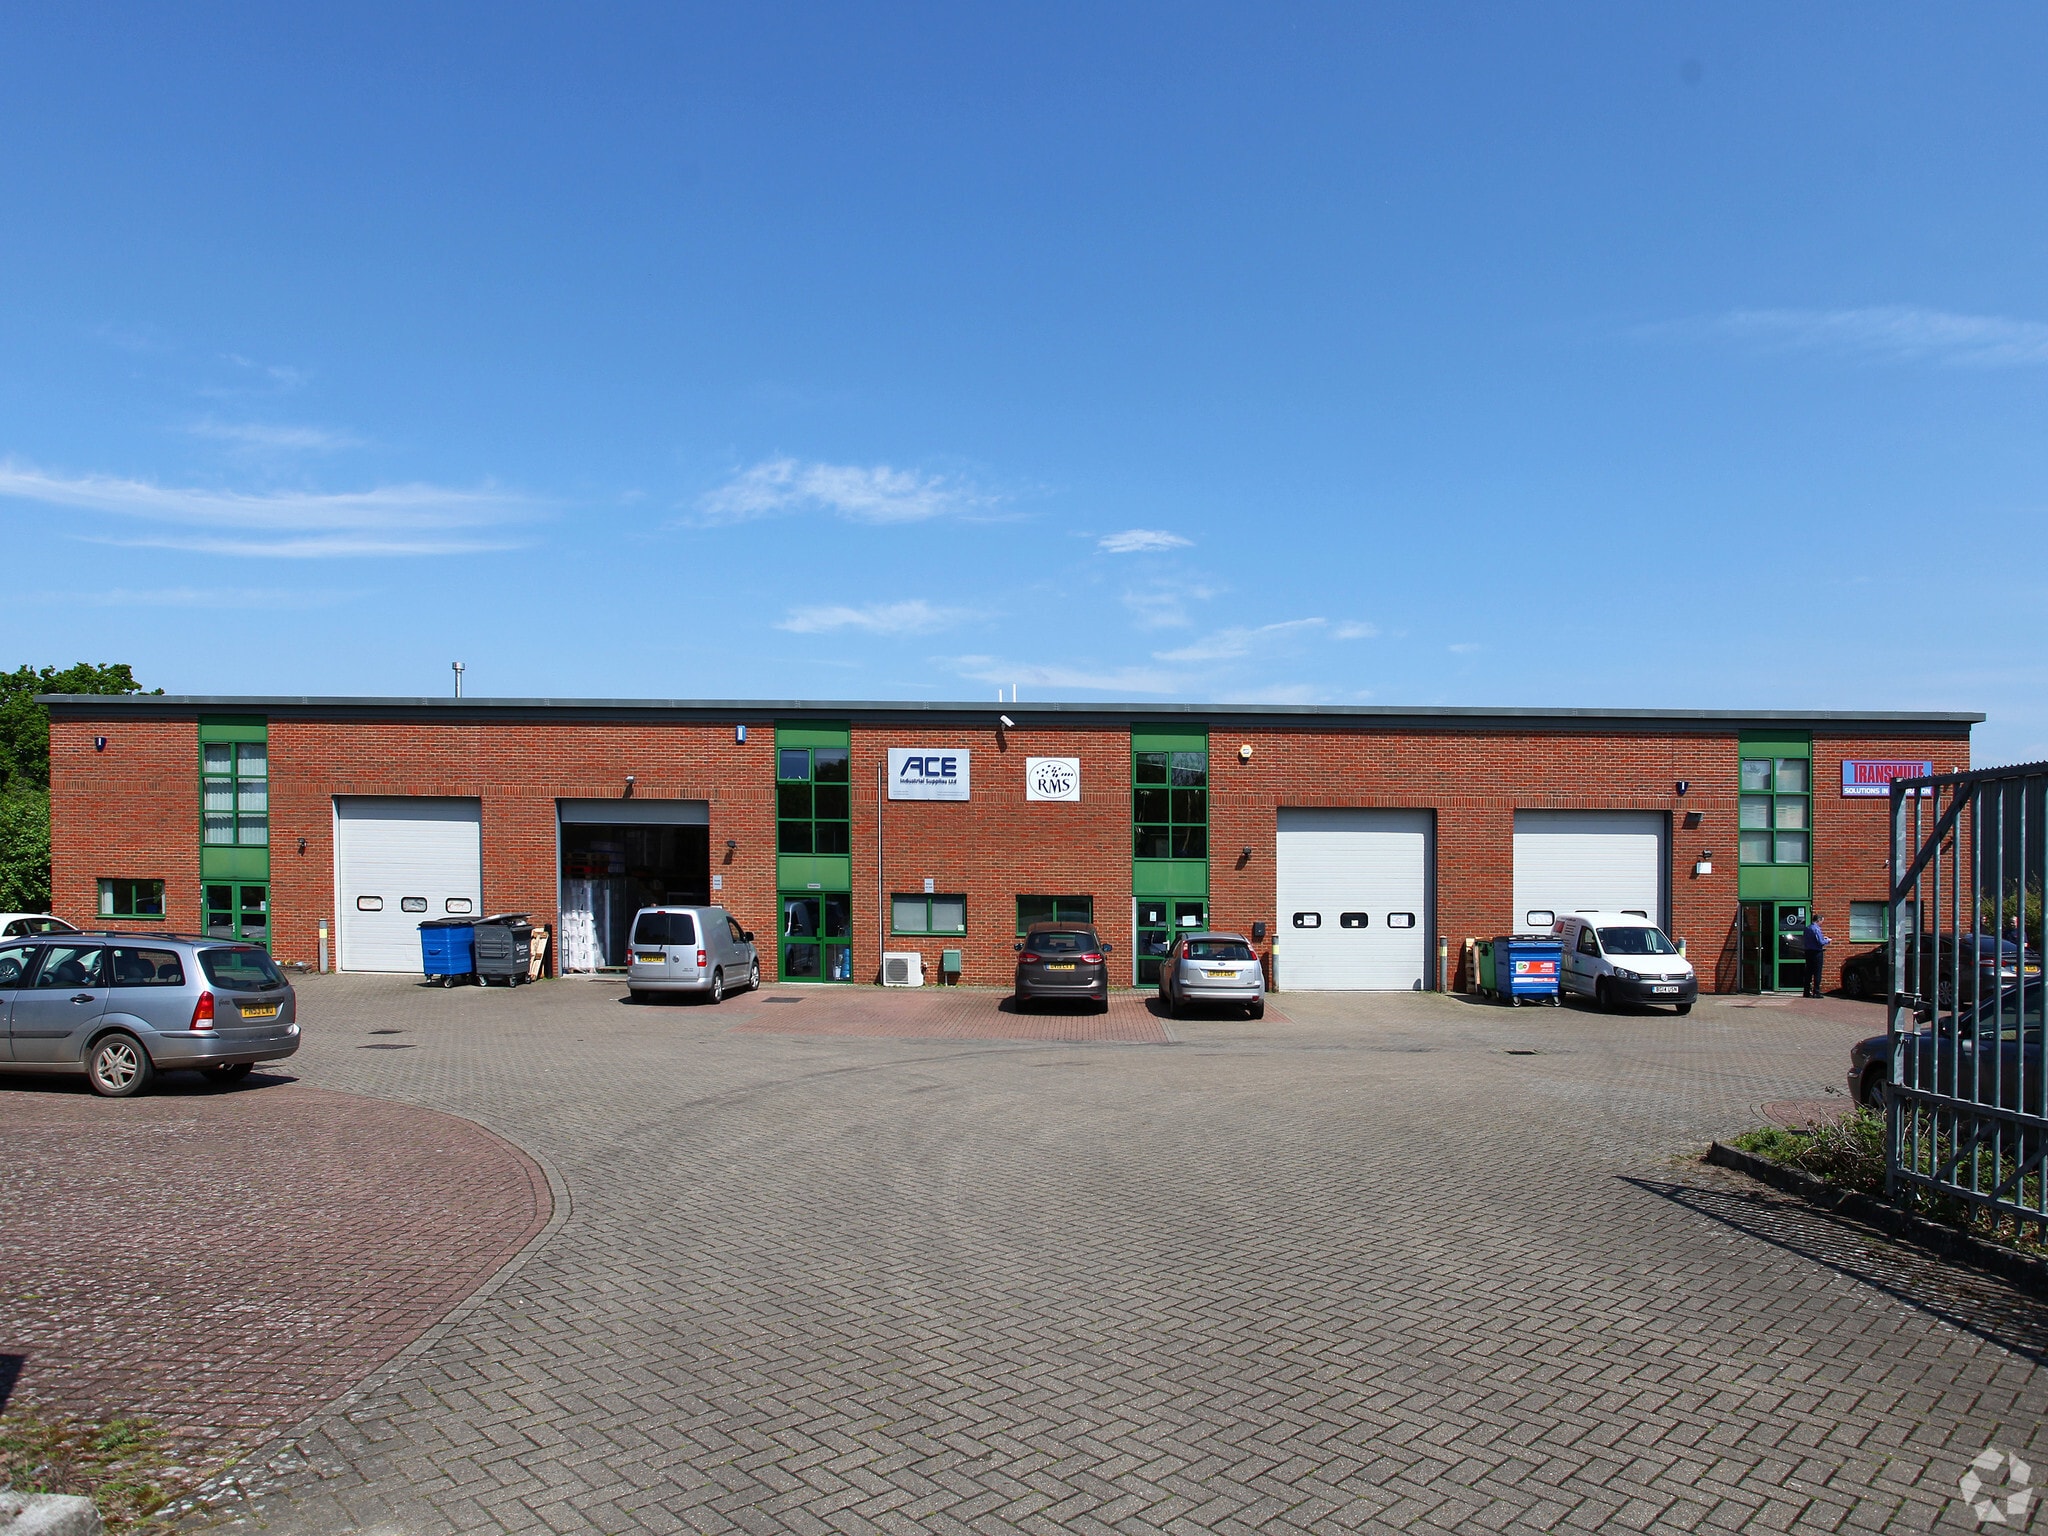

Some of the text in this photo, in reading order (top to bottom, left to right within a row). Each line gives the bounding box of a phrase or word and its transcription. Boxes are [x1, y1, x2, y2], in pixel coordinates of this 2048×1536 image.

[900, 757, 957, 777] ACE
[926, 778, 947, 786] Supplies
[1038, 779, 1070, 793] RMS
